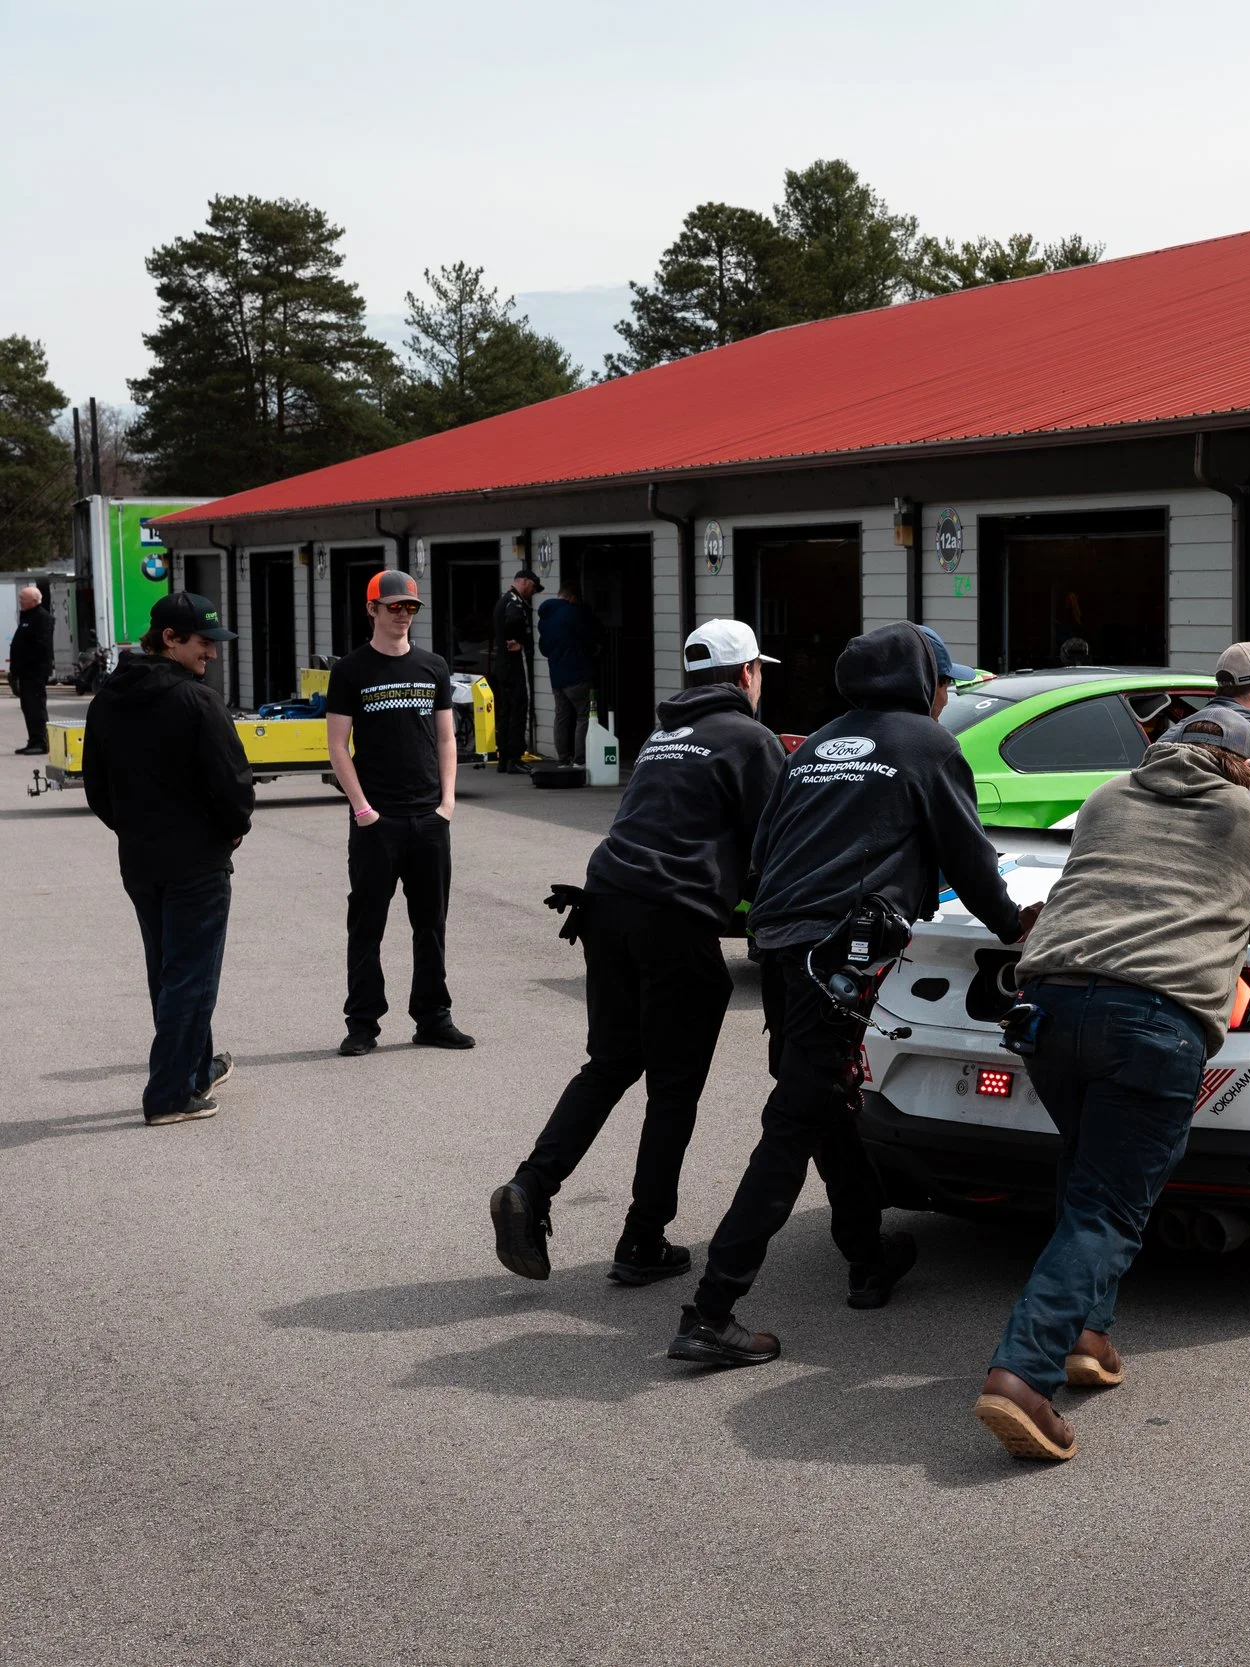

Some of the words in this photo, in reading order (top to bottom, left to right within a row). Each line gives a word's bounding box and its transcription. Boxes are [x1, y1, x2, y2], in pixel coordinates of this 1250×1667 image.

[708, 540, 718, 555] 12
[940, 532, 957, 549] 12a
[362, 689, 436, 702] PASSION-FUELED
[826, 740, 864, 756] Ford
[604, 754, 616, 762] ra
[654, 752, 684, 760] SCHOOL
[788, 764, 813, 779] FORD
[813, 761, 898, 778] PERFORMANCE
[801, 775, 833, 784] RACING
[832, 772, 865, 782] SCHOOL
